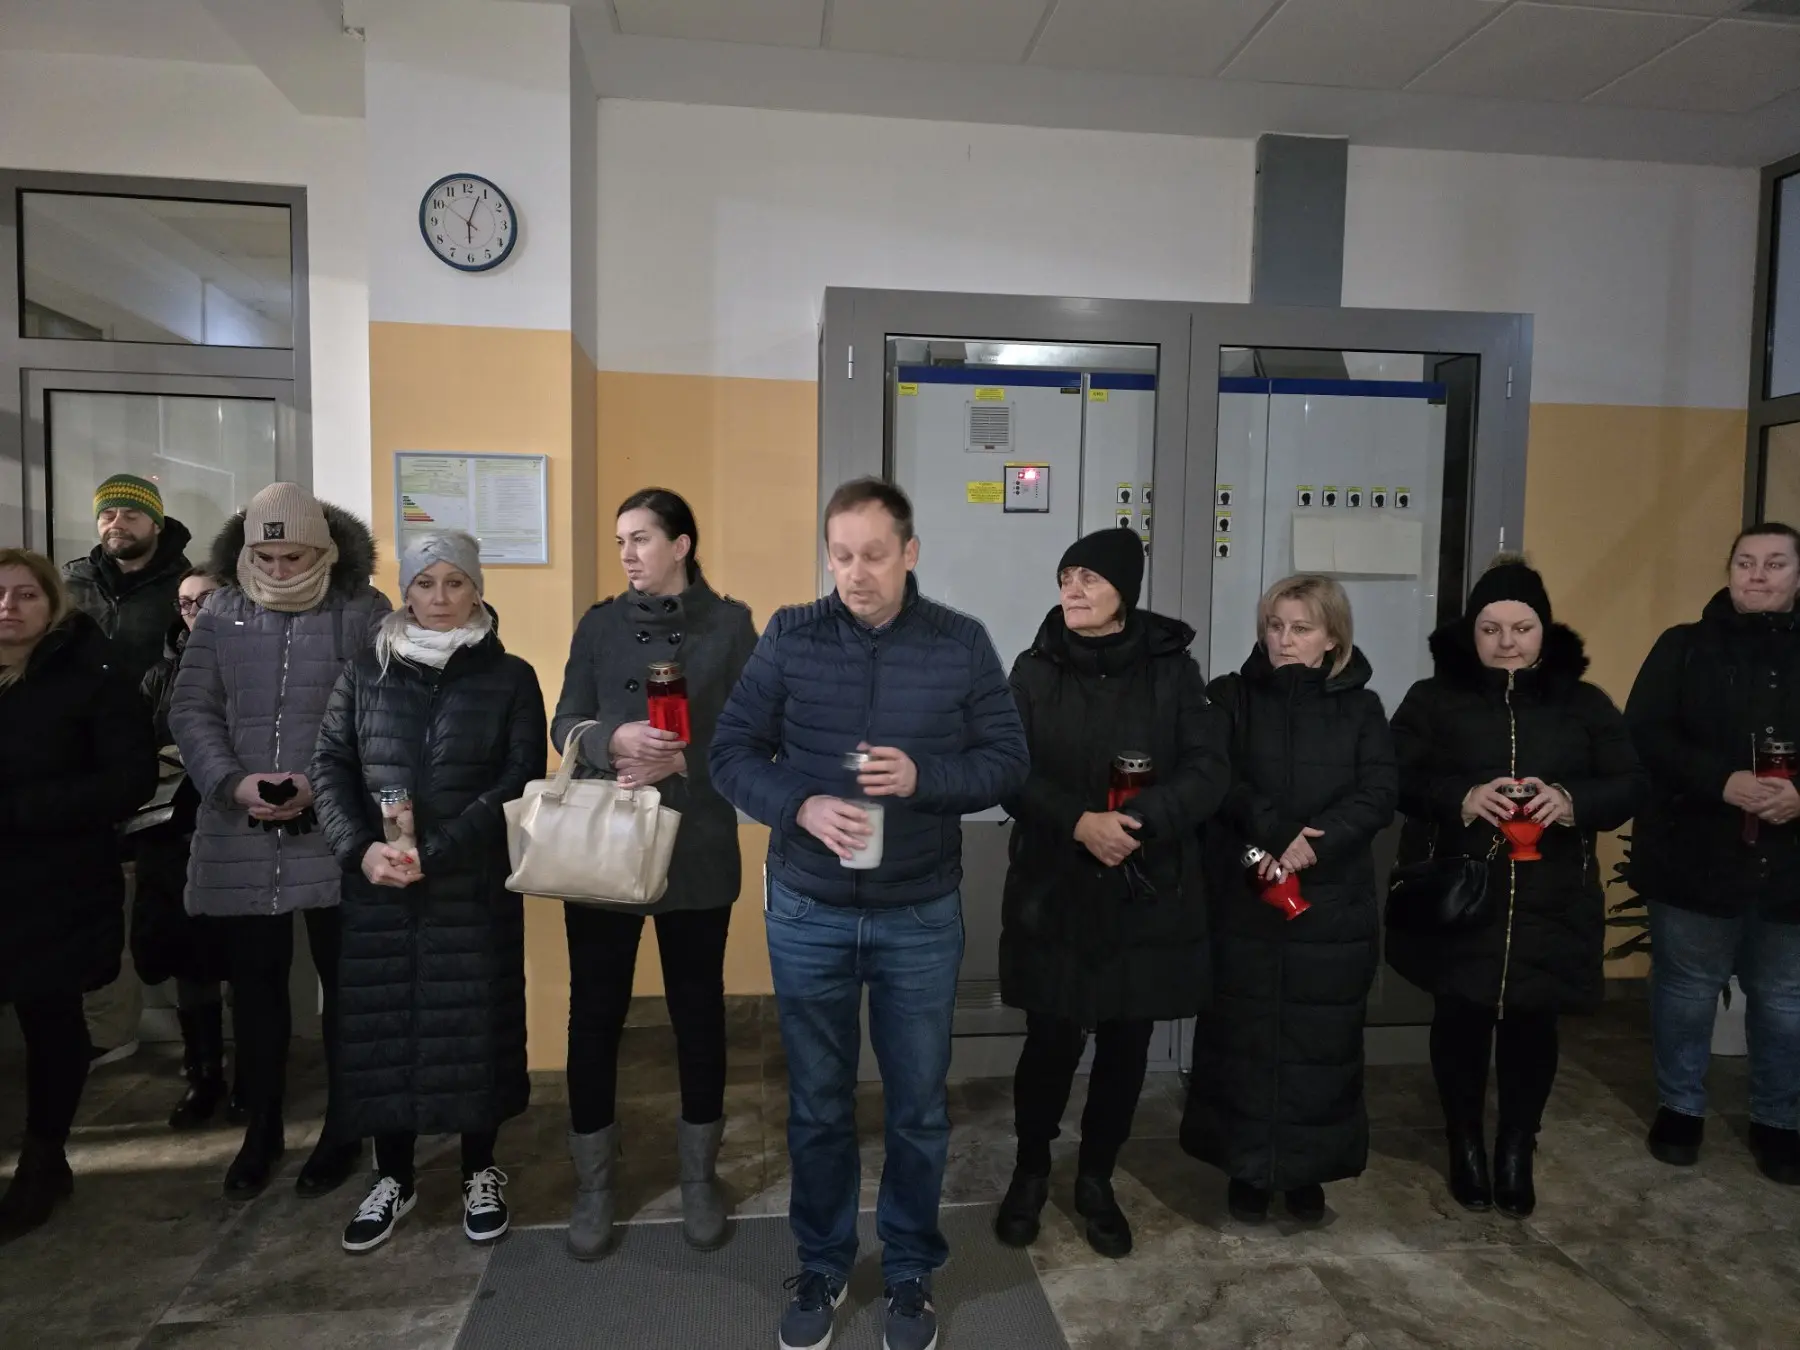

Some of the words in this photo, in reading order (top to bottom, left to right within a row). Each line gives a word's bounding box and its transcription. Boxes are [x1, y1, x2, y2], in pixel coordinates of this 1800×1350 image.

[447, 187, 454, 197] 11
[463, 184, 473, 194] 12
[433, 199, 444, 209] 10
[496, 203, 502, 212] 2
[431, 217, 438, 226] 9
[500, 220, 507, 230] 3
[437, 235, 444, 244] 8
[497, 237, 503, 247] 4
[449, 248, 456, 257] 7
[484, 250, 491, 259] 5
[467, 254, 475, 263] 6
